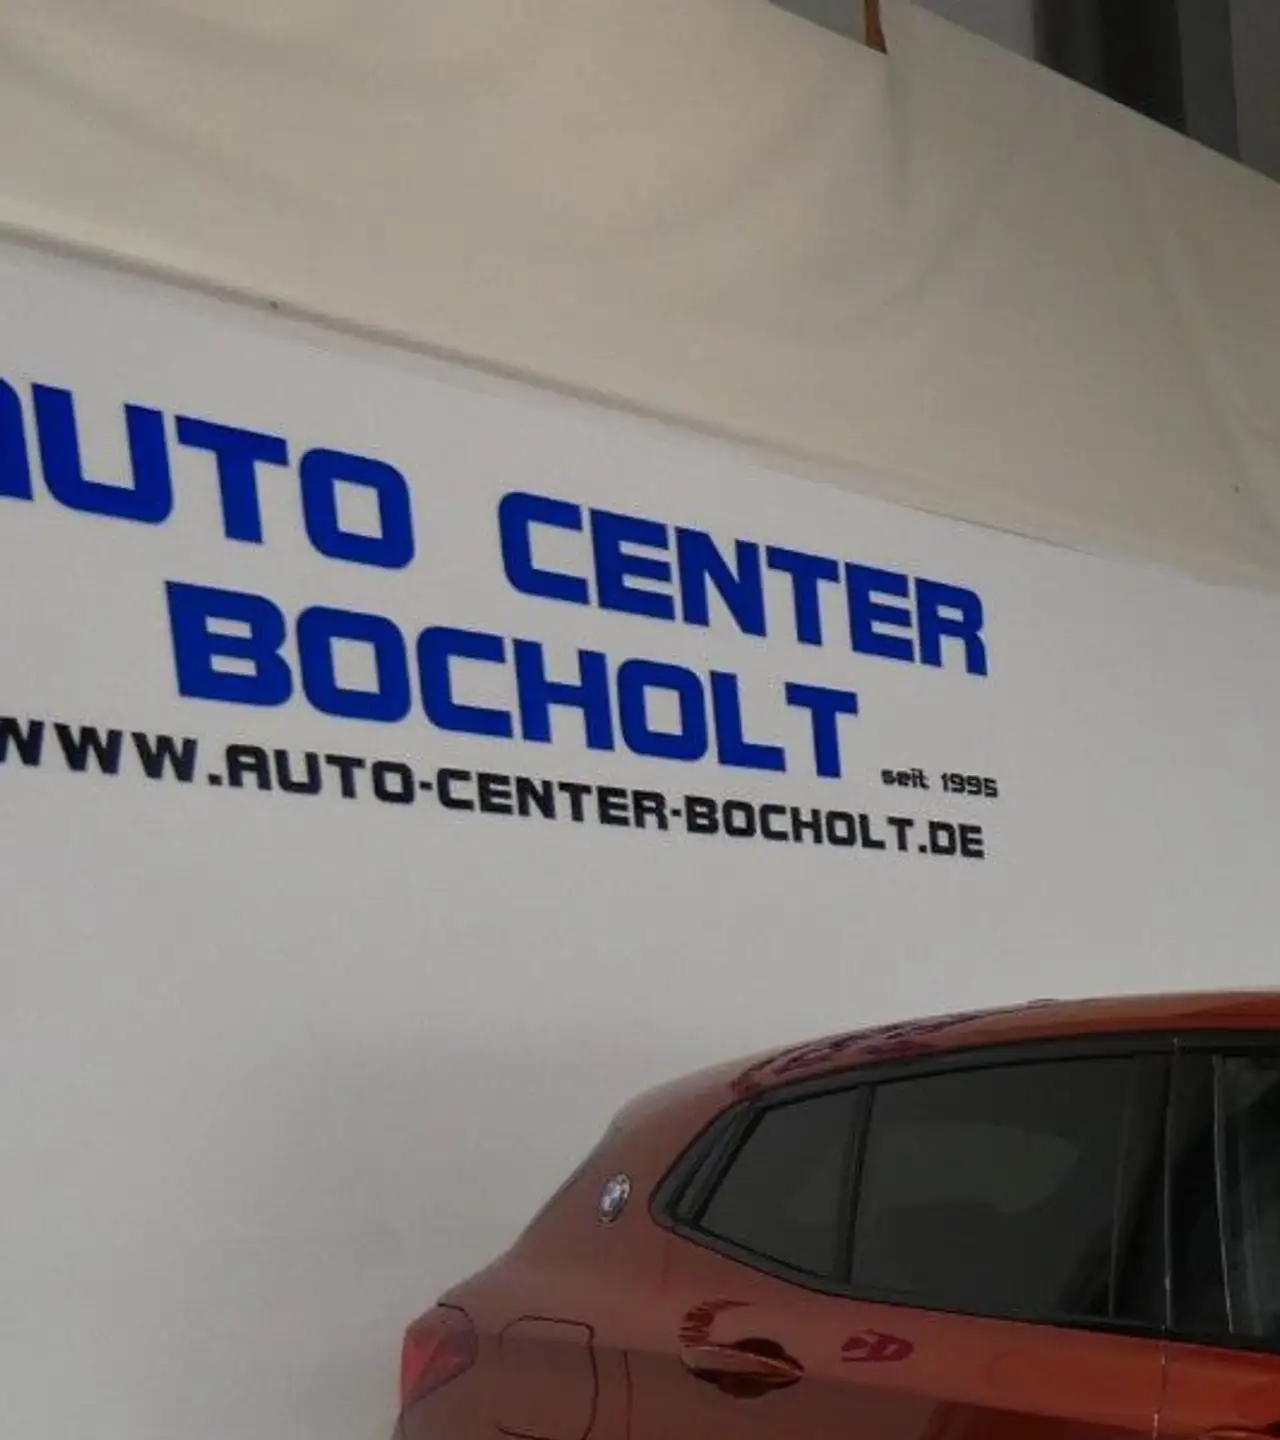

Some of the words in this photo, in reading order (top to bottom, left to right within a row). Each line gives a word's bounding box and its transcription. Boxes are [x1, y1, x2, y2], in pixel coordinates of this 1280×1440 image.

[0, 380, 415, 571] UTO
[498, 491, 989, 677] CENTER
[165, 579, 859, 780] BOCHOLT
[880, 767, 930, 791] seit
[940, 771, 999, 799] 1995
